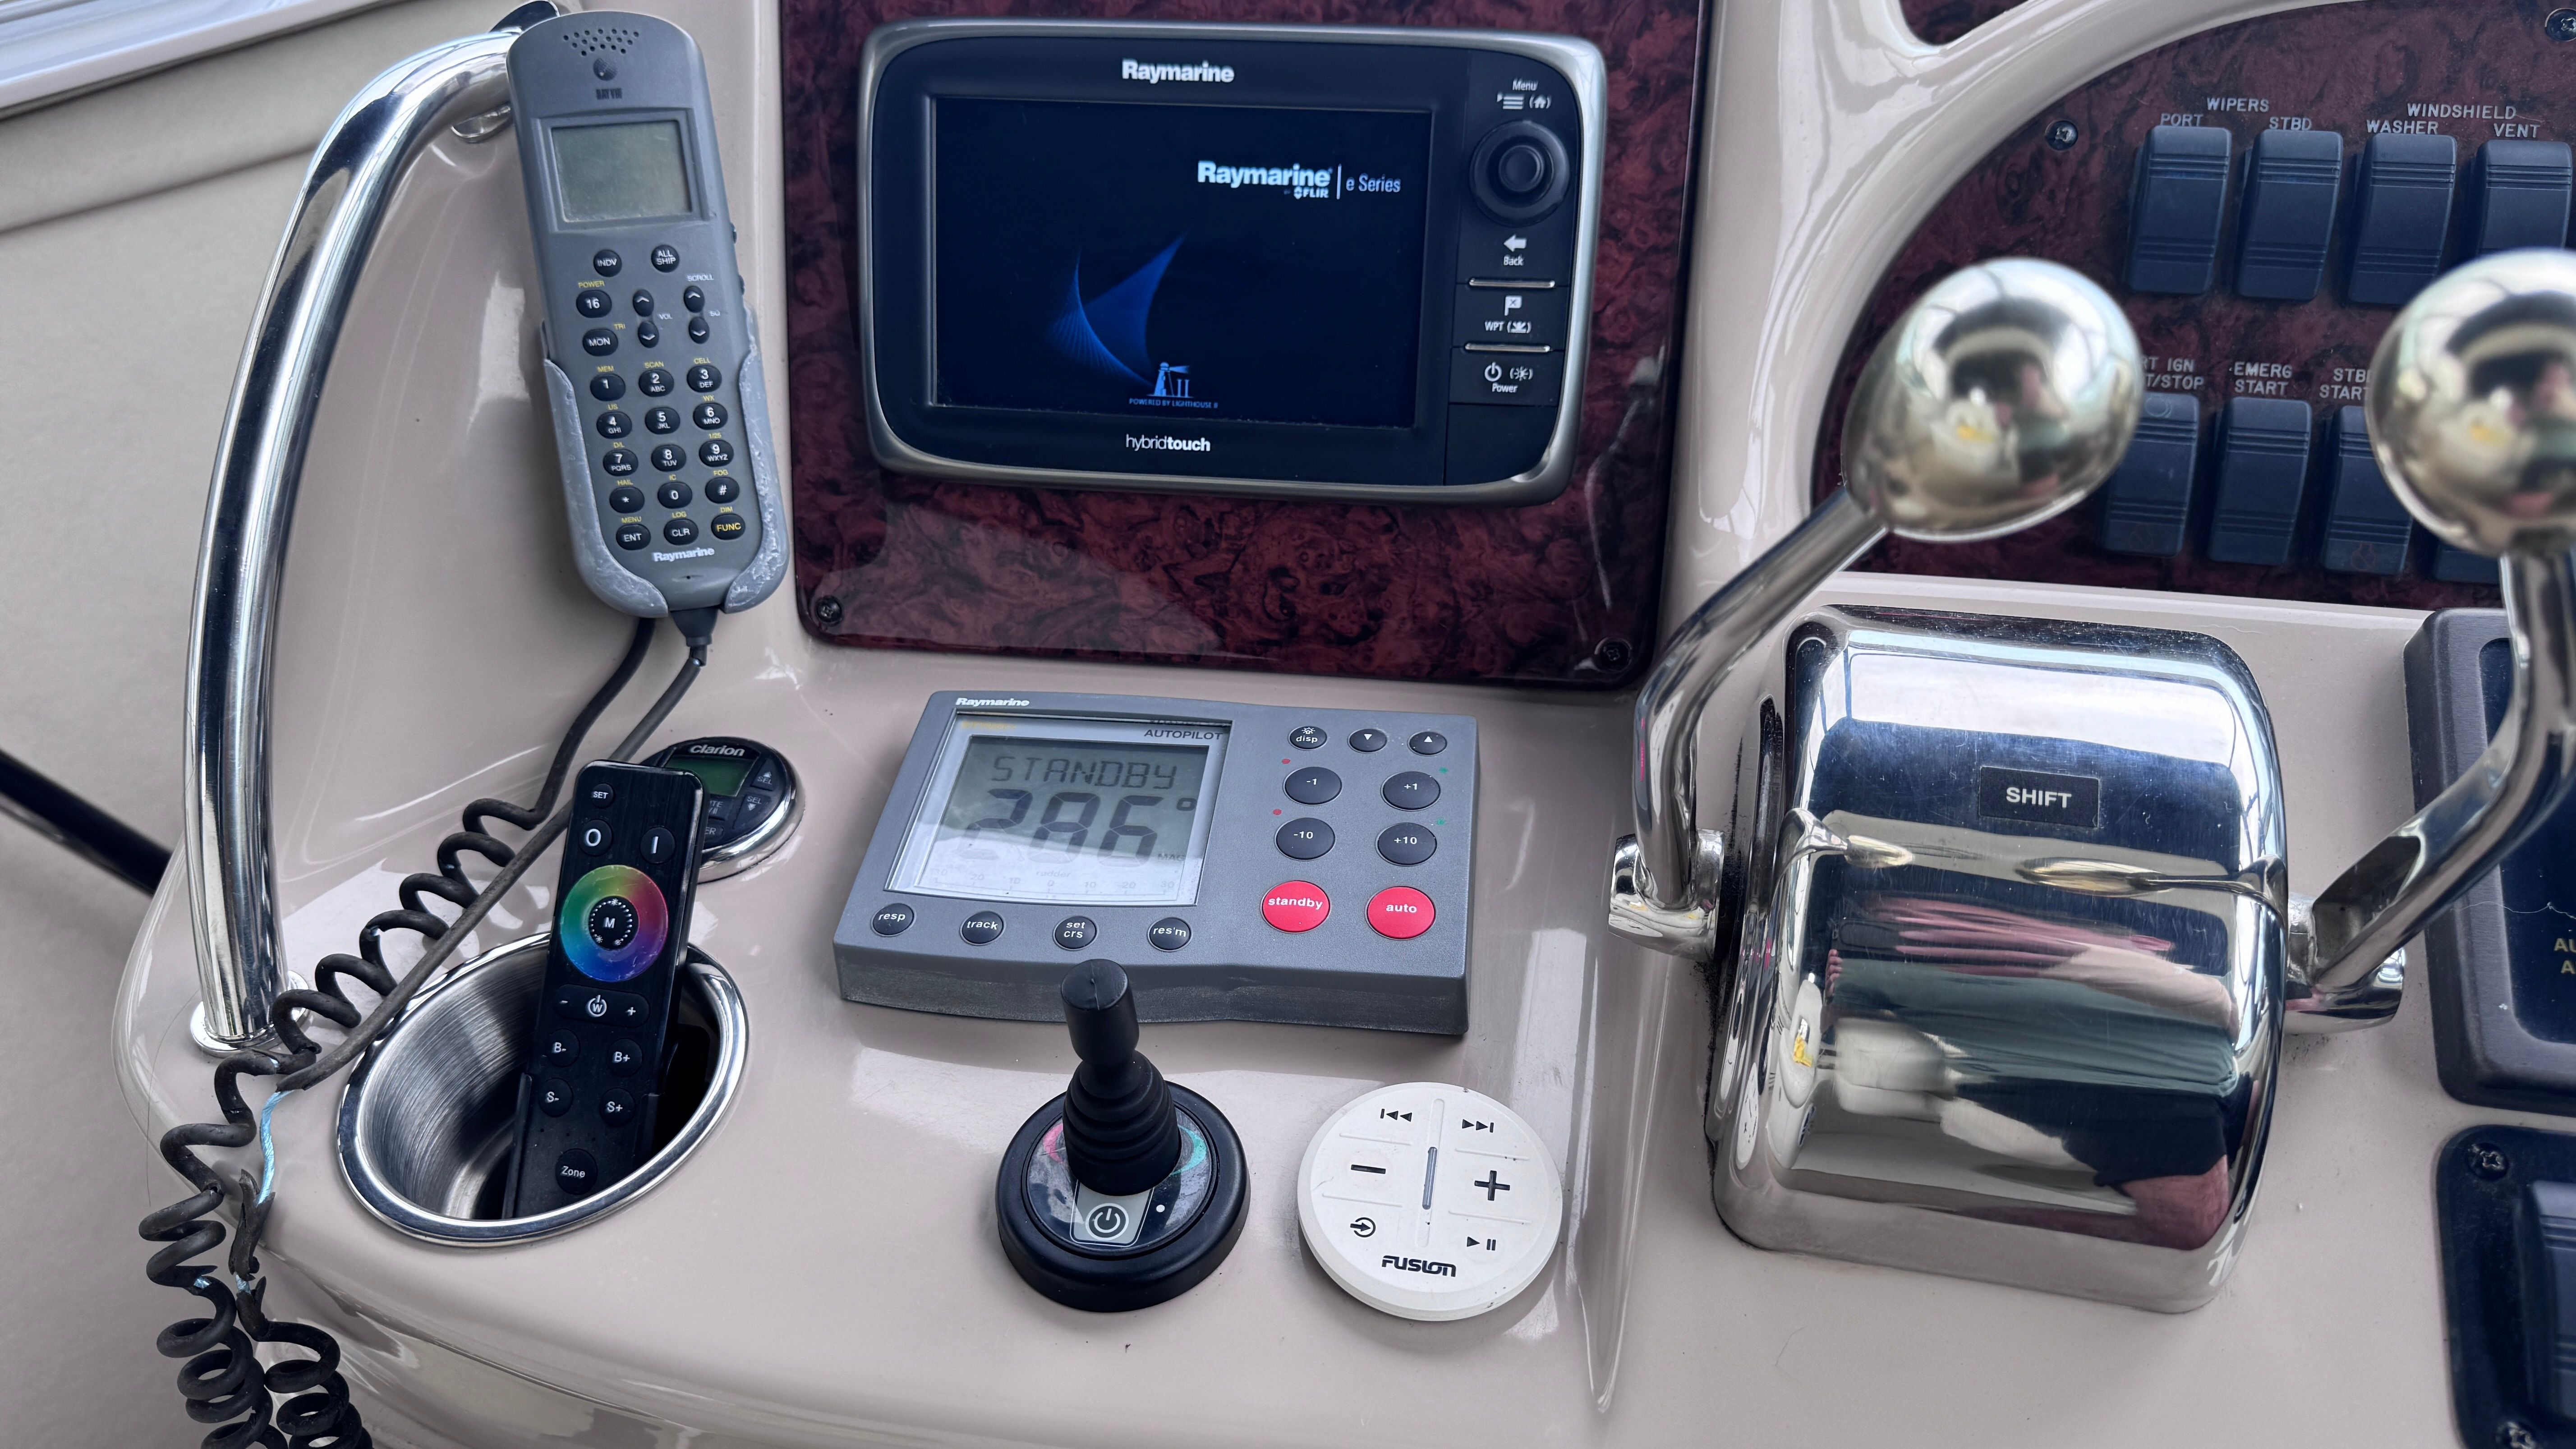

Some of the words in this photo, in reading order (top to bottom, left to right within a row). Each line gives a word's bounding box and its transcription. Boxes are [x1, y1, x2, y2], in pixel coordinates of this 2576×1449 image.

[1122, 59, 1234, 83] Raymarine
[1512, 78, 1538, 91] Menu
[2207, 97, 2269, 113] WIPERS
[2407, 103, 2516, 120] WINDSHIELD
[2160, 112, 2204, 127] PORT
[2269, 116, 2312, 132] STBD
[2367, 120, 2438, 134] WASHER
[2493, 123, 2541, 138] VENT
[1197, 161, 1331, 188] Raymarine
[1346, 177, 1355, 191] e
[1358, 173, 1401, 193] Series
[597, 258, 617, 267] INDV
[656, 257, 676, 265] SHIP
[1503, 255, 1524, 266] Back
[686, 273, 714, 281] SCROLL
[578, 280, 605, 288] POWER
[586, 298, 600, 309] 16
[1484, 321, 1505, 332] WPT
[589, 337, 611, 347] MON
[2167, 358, 2194, 373] IGN
[2234, 361, 2293, 378] EMERG
[652, 373, 660, 384] 2
[699, 368, 709, 380] 3
[603, 378, 609, 389] 1
[1492, 383, 1518, 393] Power
[2235, 379, 2289, 396] START
[659, 411, 667, 422] 5
[706, 407, 714, 417] 6
[609, 416, 617, 426] 4
[1125, 433, 1211, 451] hybridtouch
[664, 449, 672, 460] 8
[712, 444, 720, 455] 9
[614, 453, 623, 464] 7
[716, 522, 742, 532] FUNC
[623, 533, 642, 542] ENT
[672, 528, 690, 538] CLR
[653, 548, 715, 561] Raymarine
[956, 698, 1030, 707] Raymarine
[1144, 729, 1224, 740] AUTOPILOT
[1296, 735, 1318, 744] disp
[990, 755, 1178, 790] STANDBY
[758, 776, 772, 785] SEL
[1306, 777, 1318, 786] -1
[592, 791, 608, 800] SET
[747, 796, 762, 804] SEL
[2006, 787, 2072, 809] SHIFT
[1293, 831, 1314, 839] -10
[1394, 836, 1417, 845] +10
[1158, 853, 1185, 861] MAG
[1268, 897, 1323, 911] standby
[1385, 903, 1417, 914] auto
[878, 911, 906, 922] resp
[604, 917, 616, 929] M
[966, 920, 998, 930] track
[1066, 920, 1085, 929] set
[1063, 929, 1084, 939] crs
[1153, 926, 1187, 938] res'm
[552, 1042, 566, 1053] B-
[613, 1051, 630, 1063] B+
[546, 1091, 559, 1103] S-
[607, 1101, 623, 1113] S+
[561, 1166, 585, 1178] Zone
[1381, 1255, 1457, 1277] FUSION
